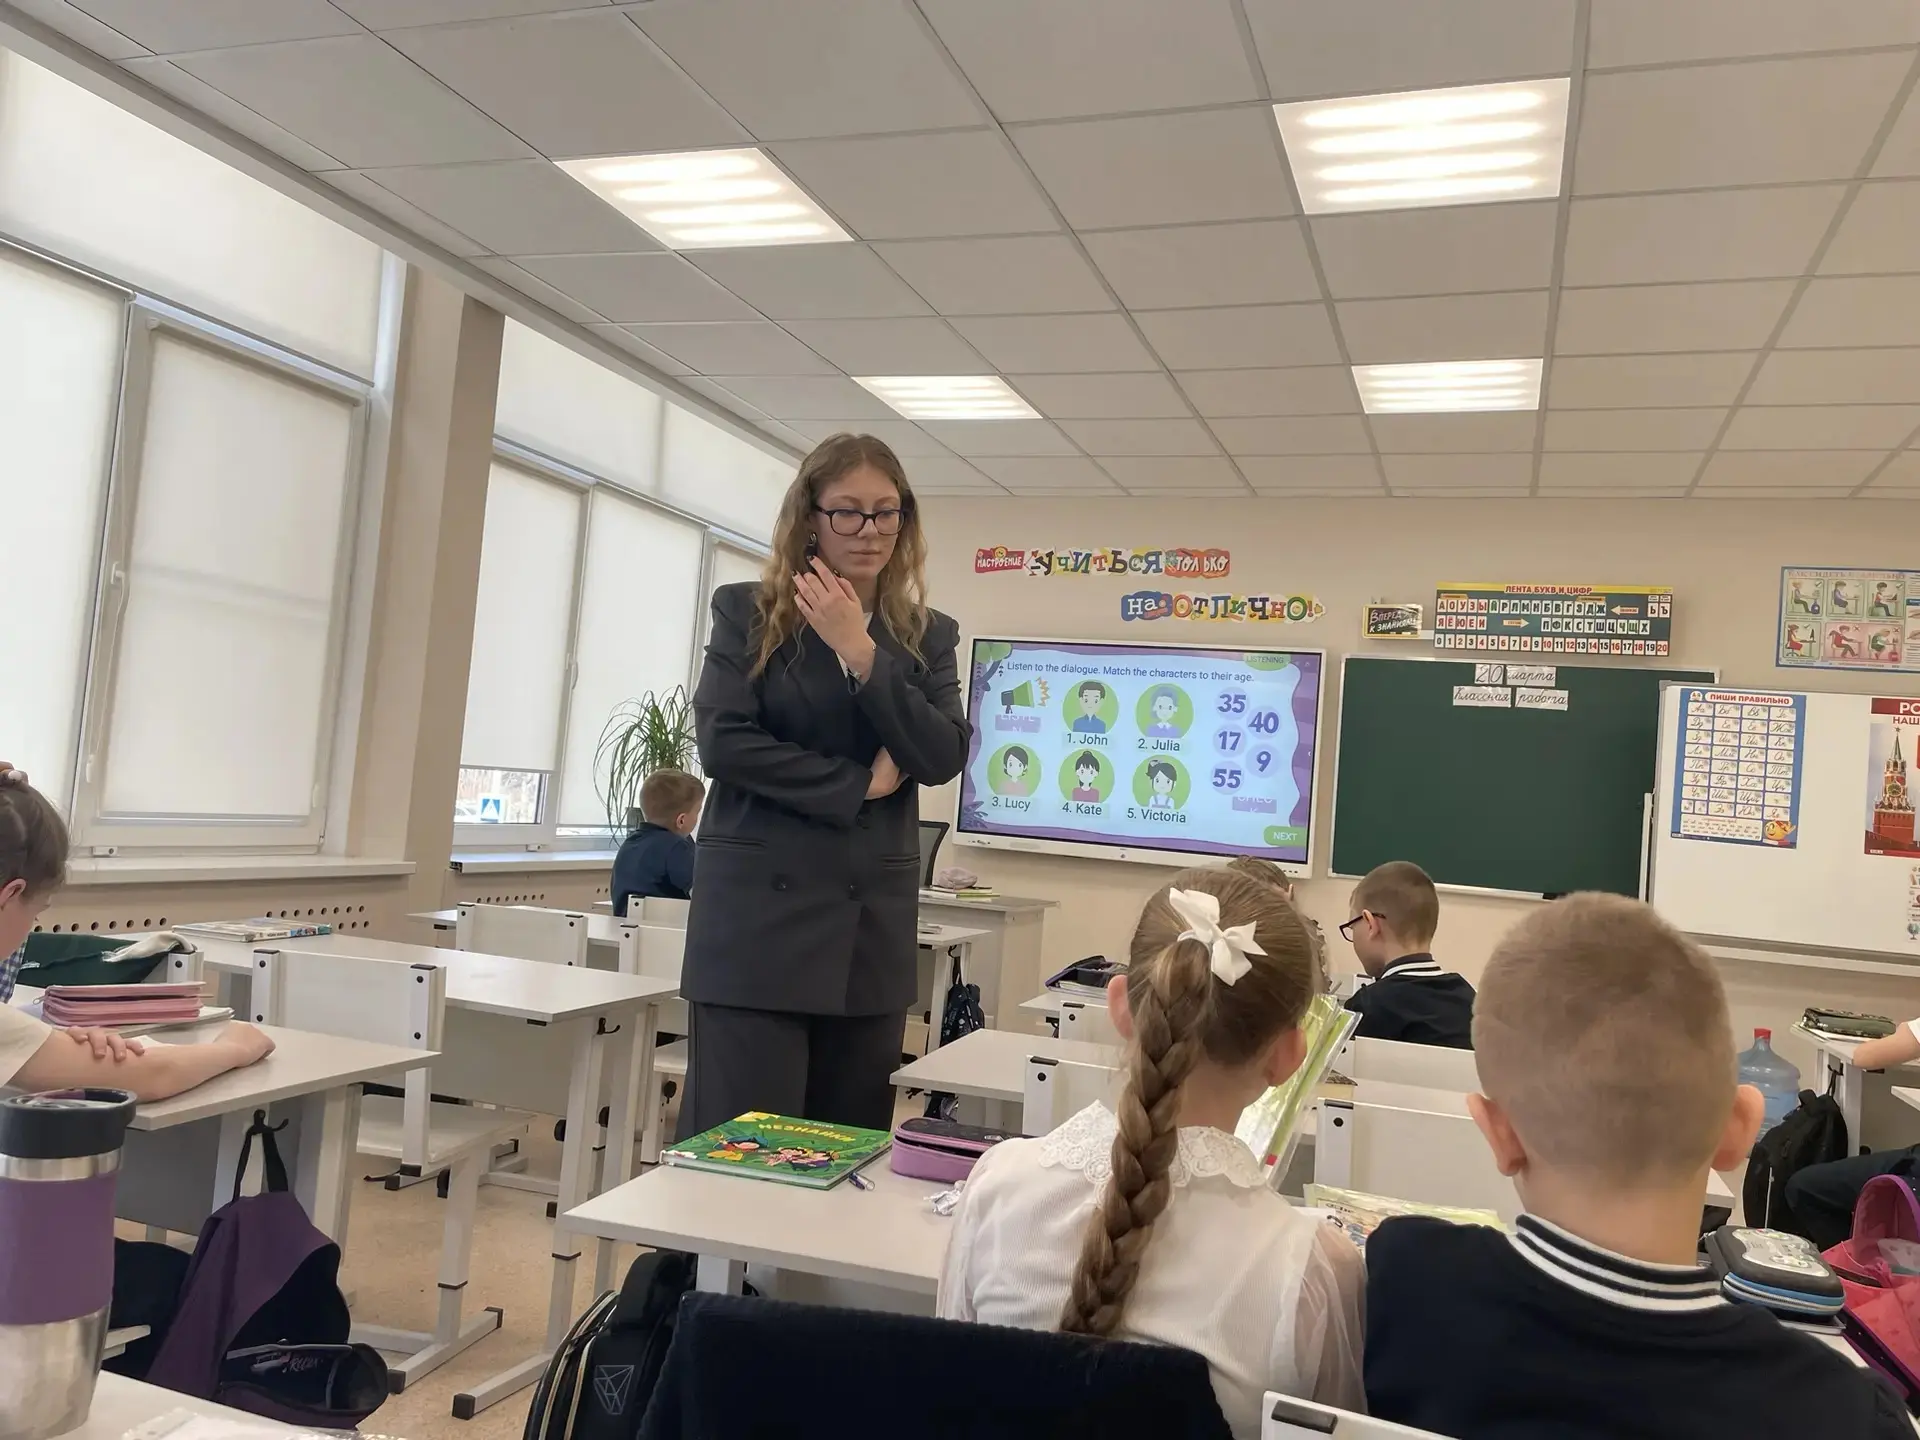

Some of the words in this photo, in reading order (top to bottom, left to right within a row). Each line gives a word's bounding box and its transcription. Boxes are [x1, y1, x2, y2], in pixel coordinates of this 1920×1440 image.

[1176, 556, 1228, 572] ТОЛЬКО
[1439, 602, 1445, 610] А
[1450, 602, 1454, 610] О
[1460, 602, 1466, 610] У
[1478, 602, 1486, 610] Ы
[1502, 603, 1508, 611] Р
[1512, 603, 1518, 611] Л
[1522, 603, 1529, 611] М
[1533, 603, 1540, 611] Н
[1544, 604, 1550, 612] Б
[1555, 604, 1560, 612] В
[1566, 604, 1571, 612] Г
[1576, 604, 1582, 612] З
[1587, 605, 1594, 614] Д
[1596, 605, 1605, 613] Ж
[1661, 606, 1668, 614] Ъ
[1469, 619, 1474, 627] Е
[1543, 621, 1549, 630] П
[1552, 622, 1560, 630] Ф
[1565, 622, 1570, 630] К
[1576, 622, 1582, 630] С
[1587, 622, 1593, 630] Т
[1596, 623, 1604, 631] Ш
[1608, 622, 1615, 632] Ц
[1619, 623, 1625, 631] Ч
[1629, 623, 1638, 632] Щ
[1641, 624, 1648, 632] Х
[1600, 642, 1608, 650] 15
[1008, 662, 1032, 671] Listen
[1035, 663, 1043, 671] to
[1046, 664, 1059, 672] the
[1061, 664, 1100, 676] dialogue.
[1103, 666, 1130, 676] Match
[1133, 667, 1147, 676] the
[1150, 669, 1197, 679] characters
[1212, 671, 1232, 680] their
[1234, 674, 1254, 683] age.
[1476, 665, 1502, 682] 20
[1508, 671, 1554, 685] марта
[1218, 694, 1246, 713] 35
[1454, 687, 1509, 701] Классная
[1516, 689, 1566, 707] работа
[1739, 696, 1789, 704] ПРАВИЛЬНО
[1248, 711, 1279, 733] 40
[1067, 733, 1076, 743] 1.
[1080, 734, 1108, 745] John
[1138, 739, 1147, 749] 2.
[1152, 740, 1180, 751] Julia
[1219, 731, 1241, 750] 17
[1257, 751, 1271, 772] 9
[1212, 769, 1242, 788] 55
[992, 797, 1001, 807] 3.
[1005, 798, 1030, 812] Lucy
[1062, 803, 1072, 813] 4.
[1076, 804, 1102, 816] Kate
[1127, 809, 1137, 819] 5.
[1141, 809, 1186, 823] Victoria
[1273, 832, 1298, 840] NEXT
